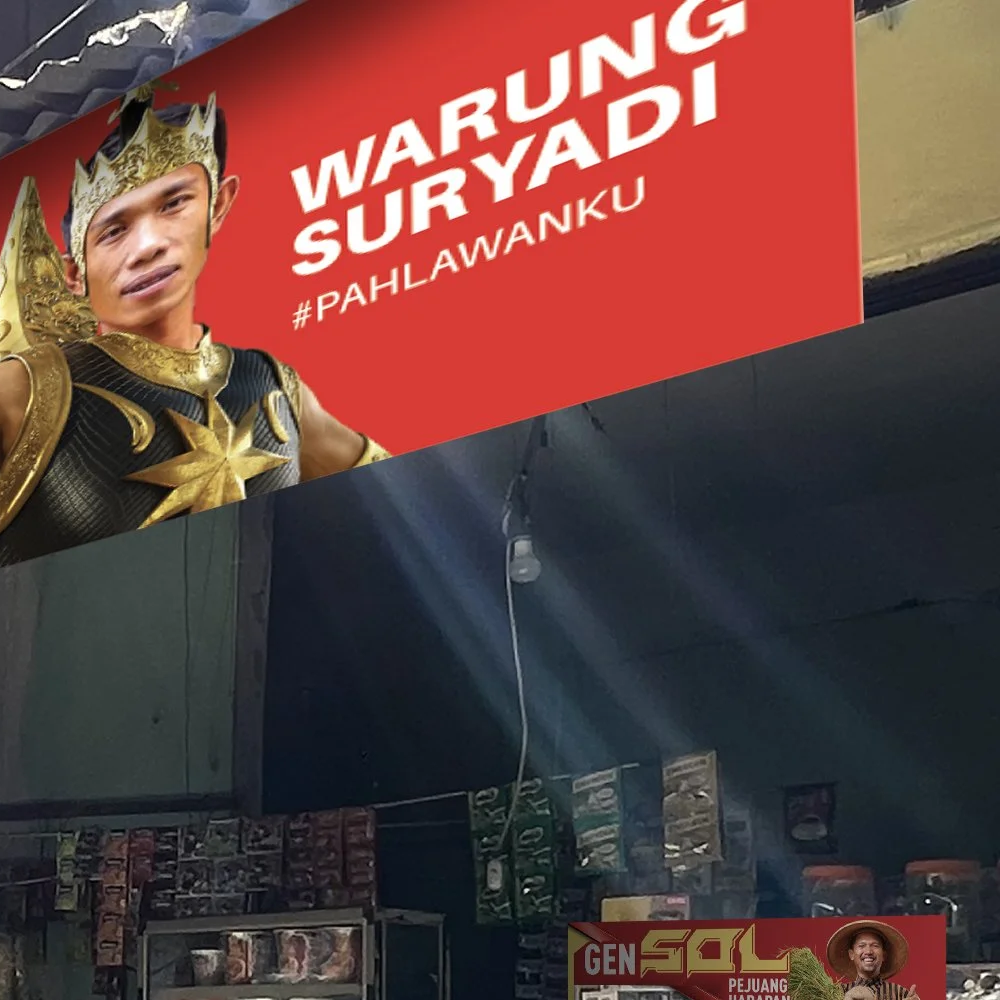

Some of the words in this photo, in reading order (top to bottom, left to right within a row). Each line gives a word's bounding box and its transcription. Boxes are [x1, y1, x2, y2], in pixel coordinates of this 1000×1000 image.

[290, 0, 748, 213] WARUNG
[292, 61, 718, 276] SURYADI
[292, 176, 646, 330] #PAHLAWANKU
[584, 943, 636, 976] GEN
[640, 923, 791, 979] SOL
[728, 977, 789, 994] PEJUANG
